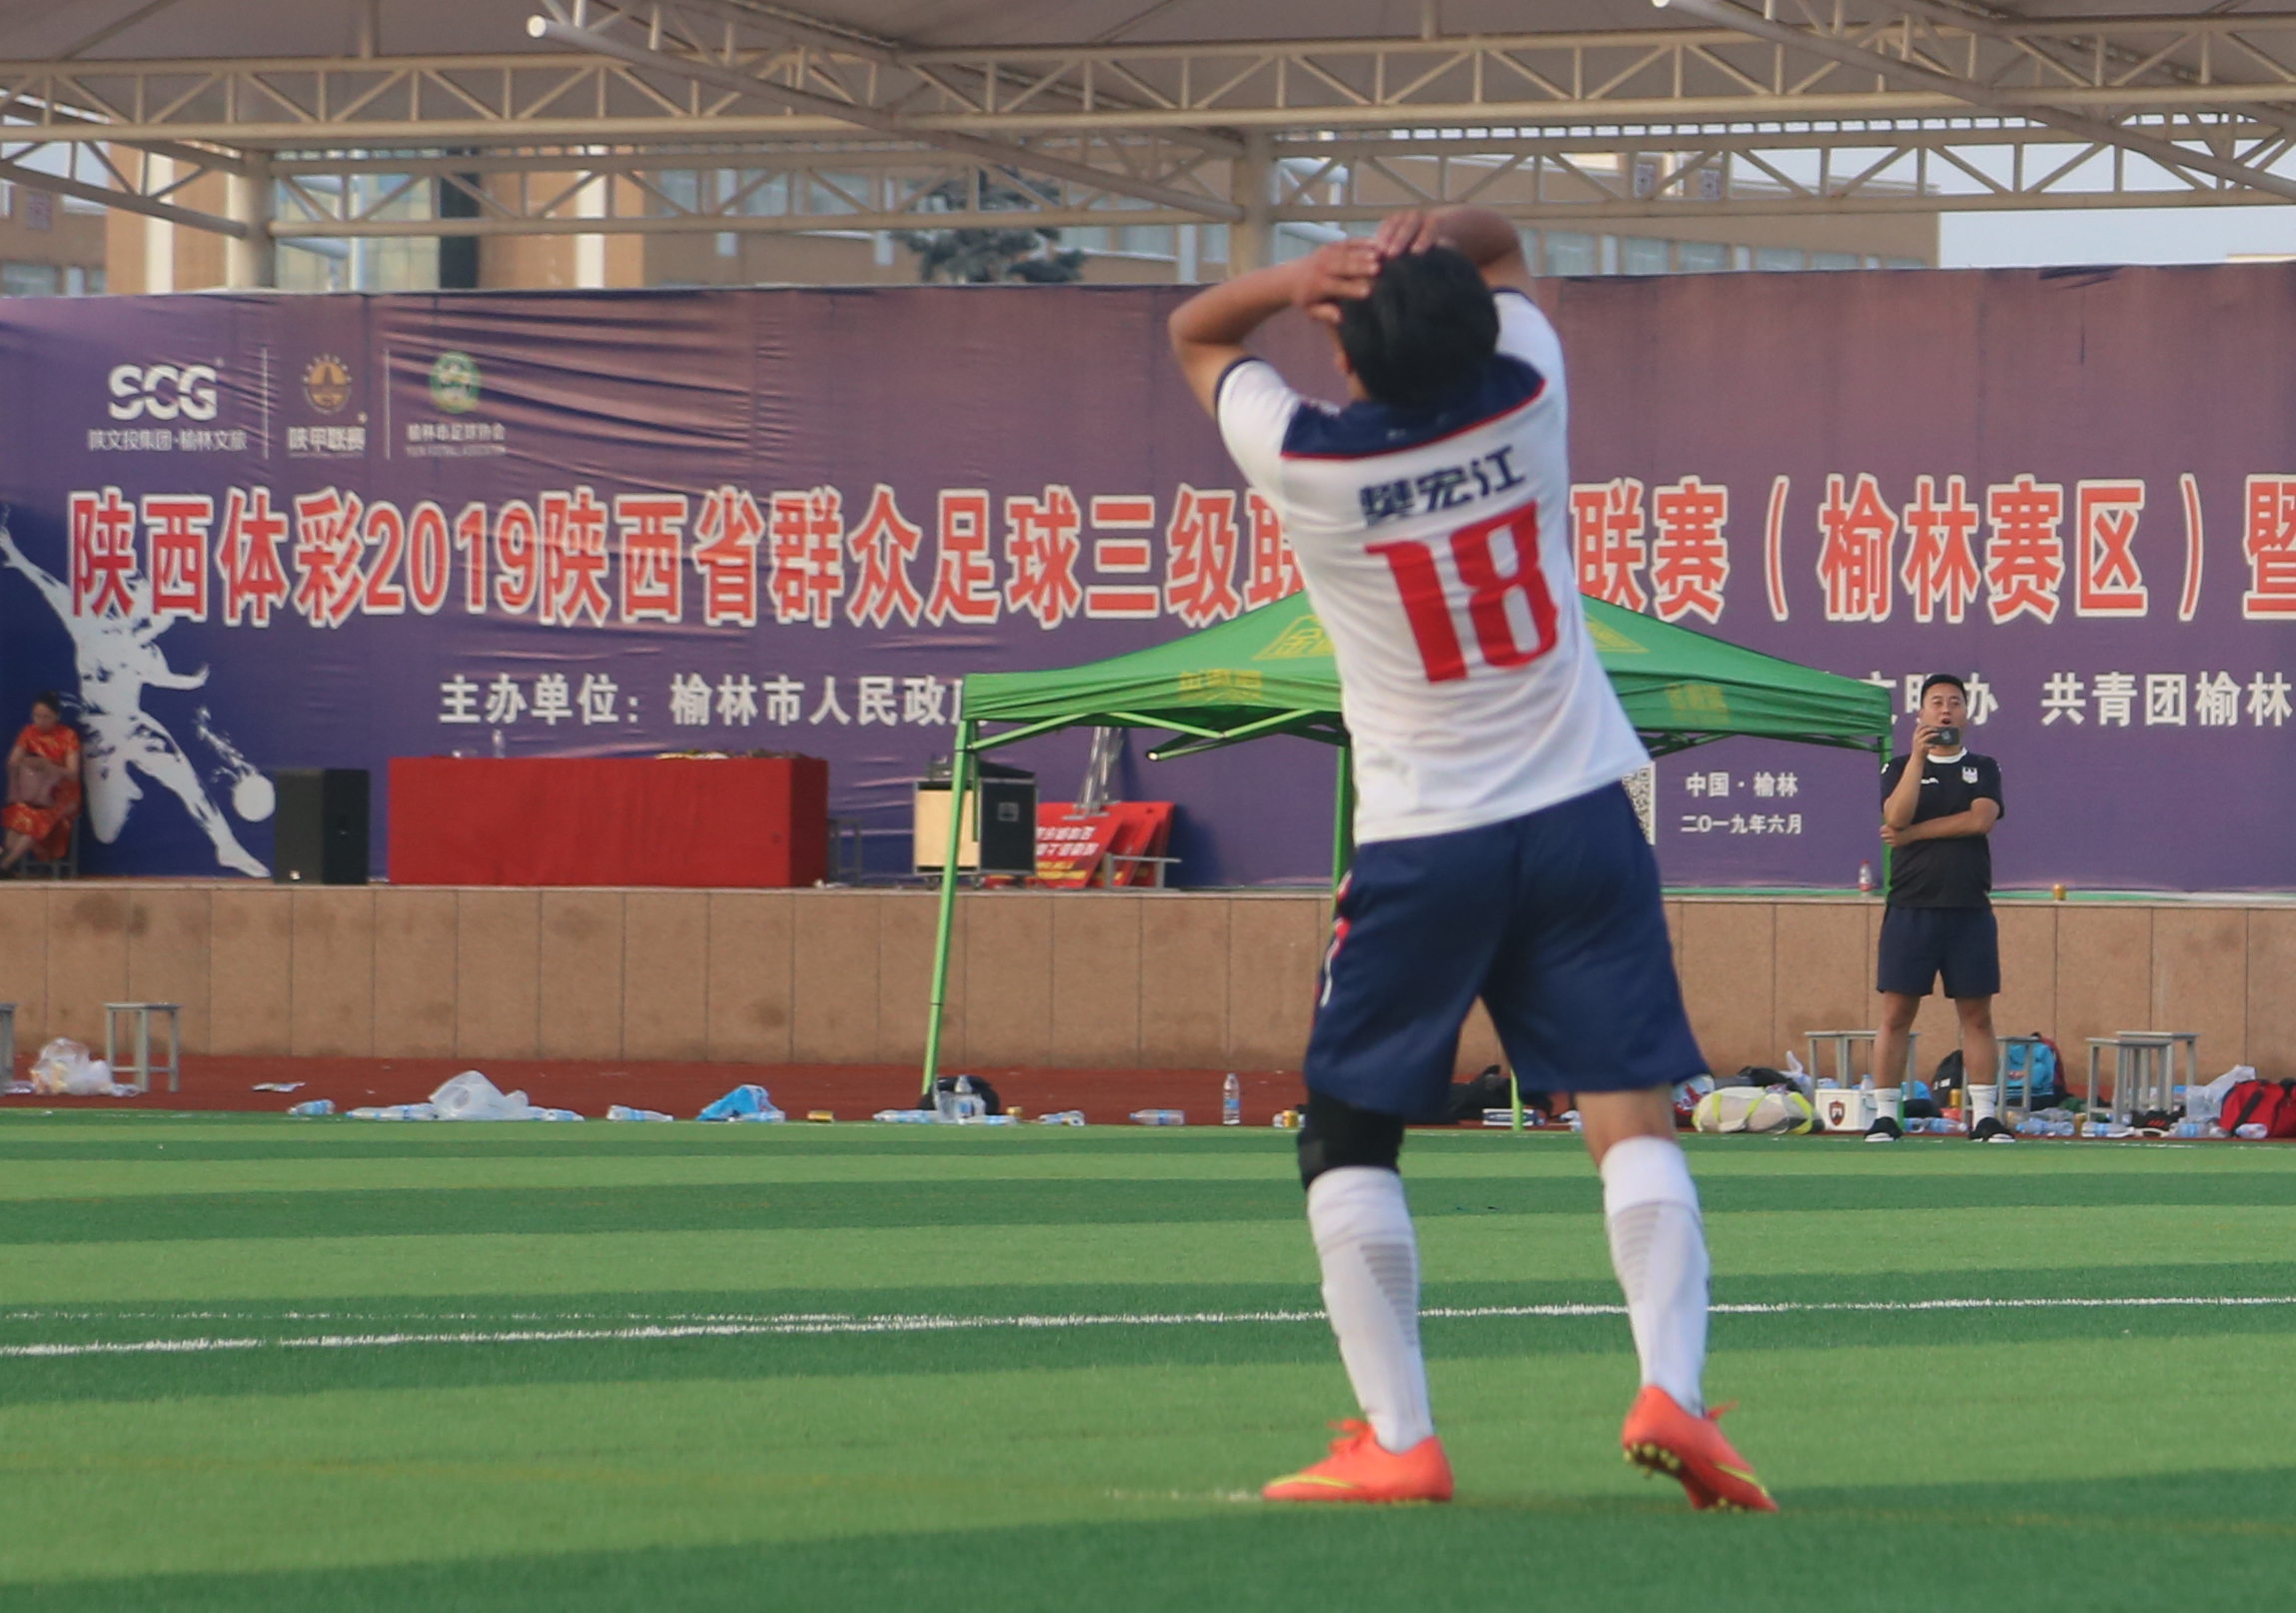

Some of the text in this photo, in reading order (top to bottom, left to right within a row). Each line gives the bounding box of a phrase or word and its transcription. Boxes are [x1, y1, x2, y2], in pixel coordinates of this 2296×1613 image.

[109, 364, 217, 421] SCG
[1364, 498, 1559, 684] 18
[2040, 670, 2293, 728] 共青团榆林
